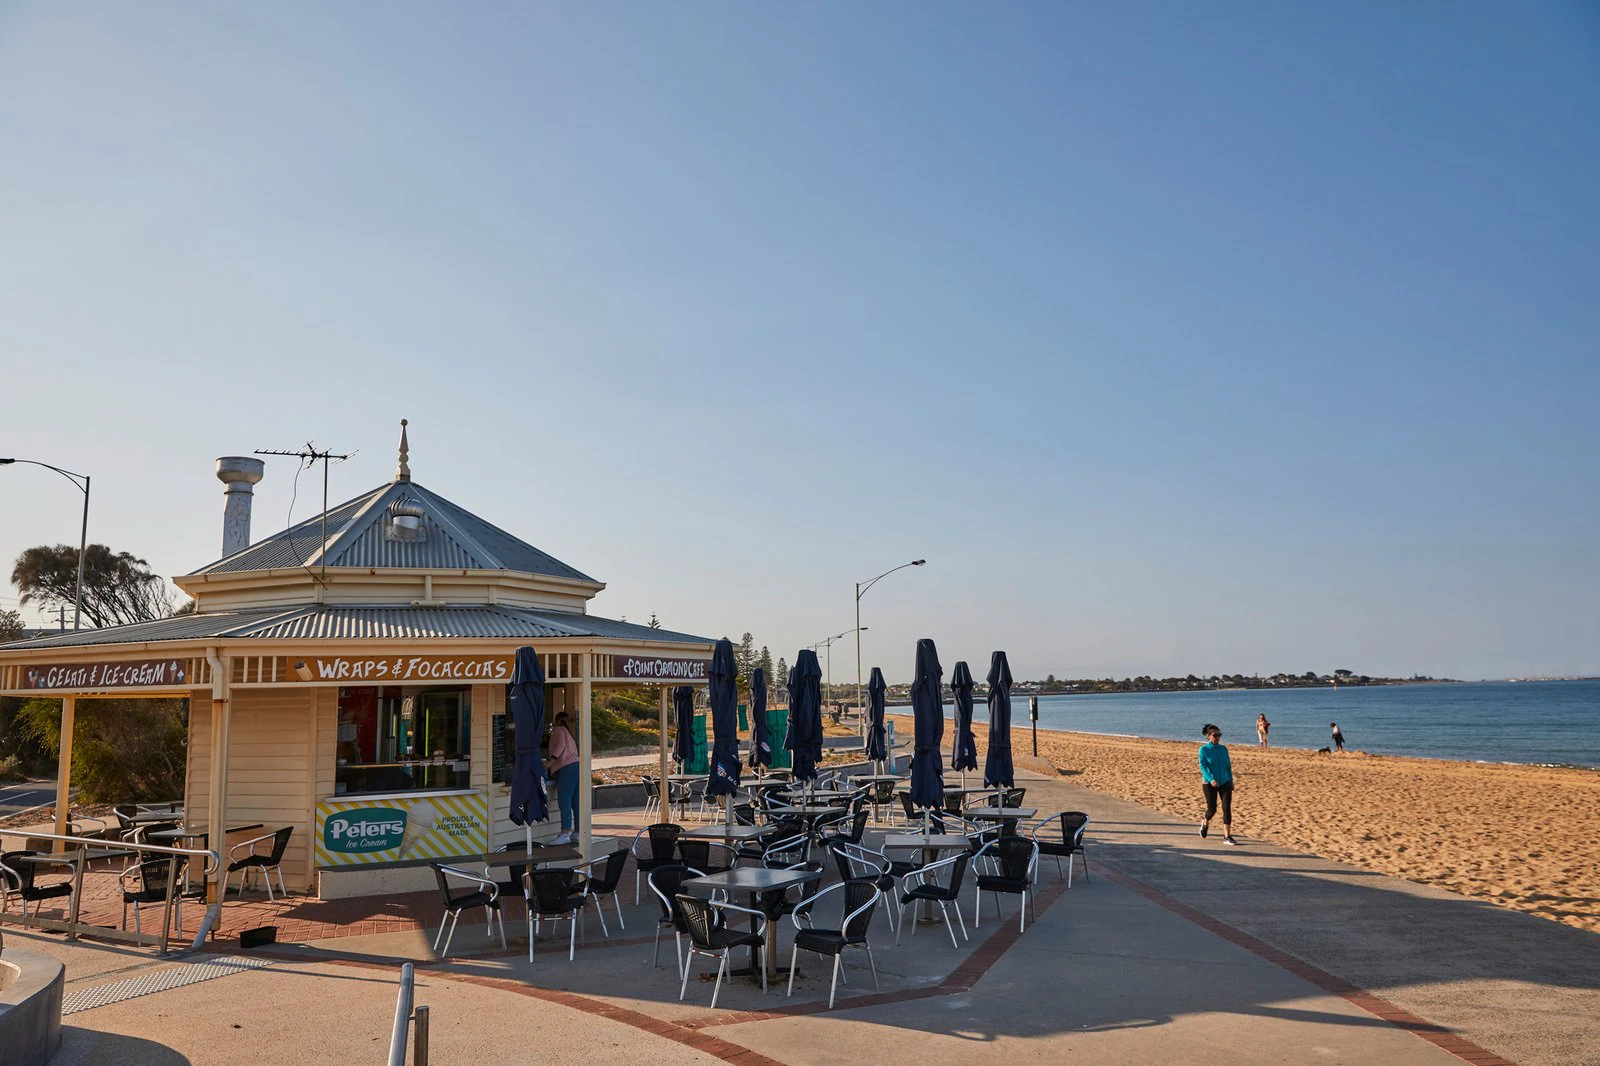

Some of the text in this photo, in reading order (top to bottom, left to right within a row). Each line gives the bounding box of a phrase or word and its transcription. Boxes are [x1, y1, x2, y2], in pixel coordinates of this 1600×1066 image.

[47, 662, 166, 688] GELATI & ICE-CREAM
[316, 657, 507, 679] WRAPS & FOCACCIAS
[623, 658, 705, 678] POINT ORMOND CAFE
[330, 819, 404, 839] Peters
[436, 821, 481, 831] AUSTRALIAN
[442, 815, 475, 823] PROUDLY
[345, 838, 388, 849] Ice Cream
